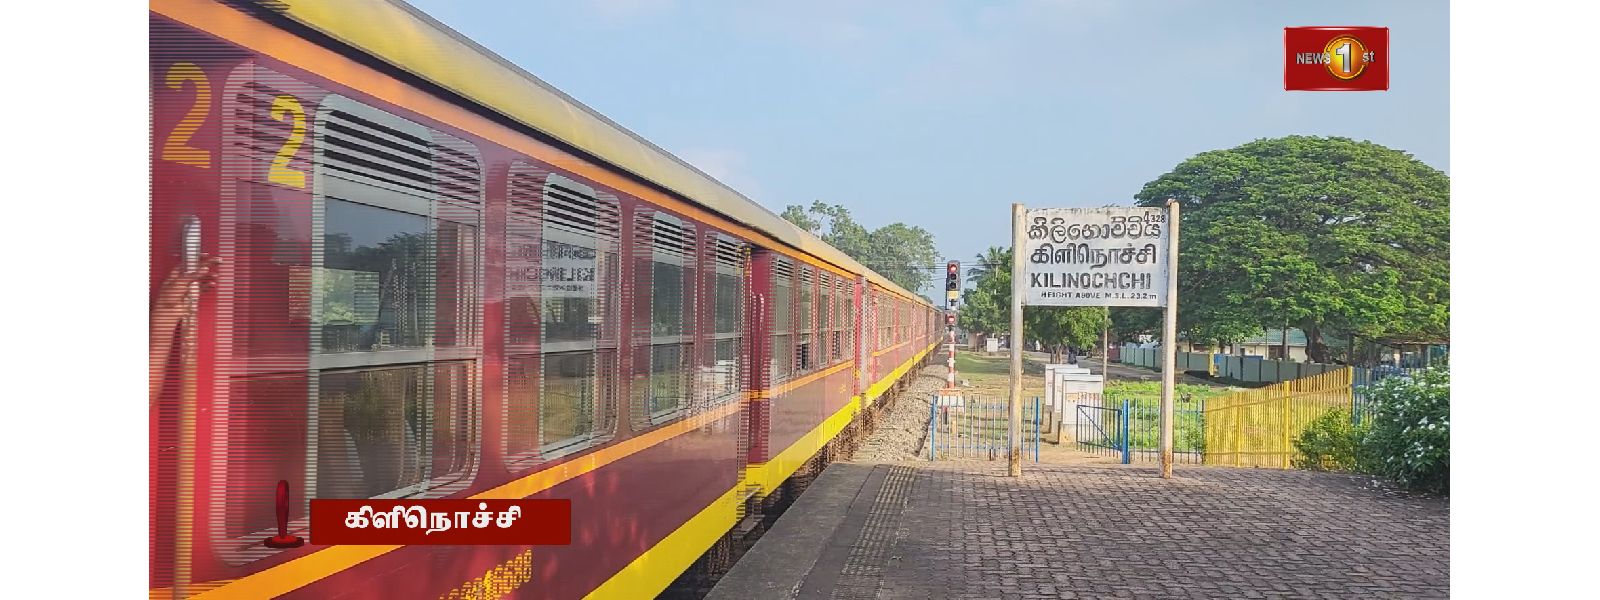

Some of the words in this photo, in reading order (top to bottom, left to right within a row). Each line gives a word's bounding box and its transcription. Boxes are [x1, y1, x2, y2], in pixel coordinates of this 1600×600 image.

[161, 62, 211, 168] 2
[267, 95, 306, 188] 2
[1030, 242, 1157, 270] கிளிநொச்சி
[1030, 272, 1152, 290] KILINOCHCHI
[1041, 291, 1072, 299] HEIGHT
